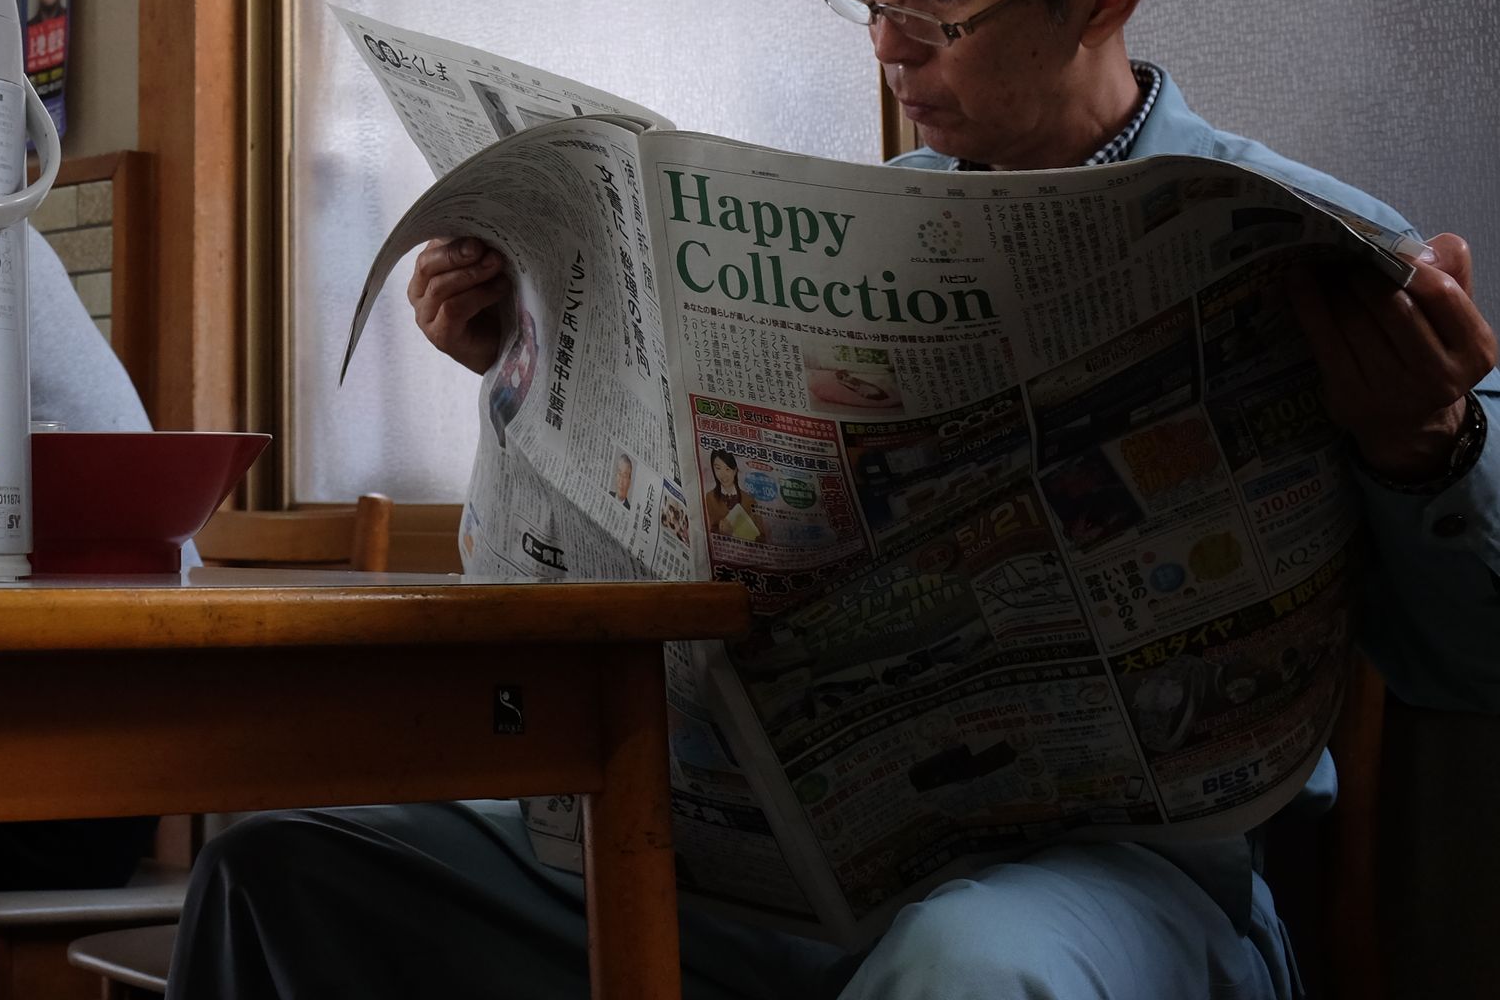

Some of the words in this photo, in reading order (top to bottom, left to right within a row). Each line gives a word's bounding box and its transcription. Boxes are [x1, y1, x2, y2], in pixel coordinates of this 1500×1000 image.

[663, 170, 856, 257] Happy
[676, 238, 1001, 324] Collection
[1118, 618, 1235, 674] 大粒ダイヤ
[1202, 759, 1264, 795] BEST
